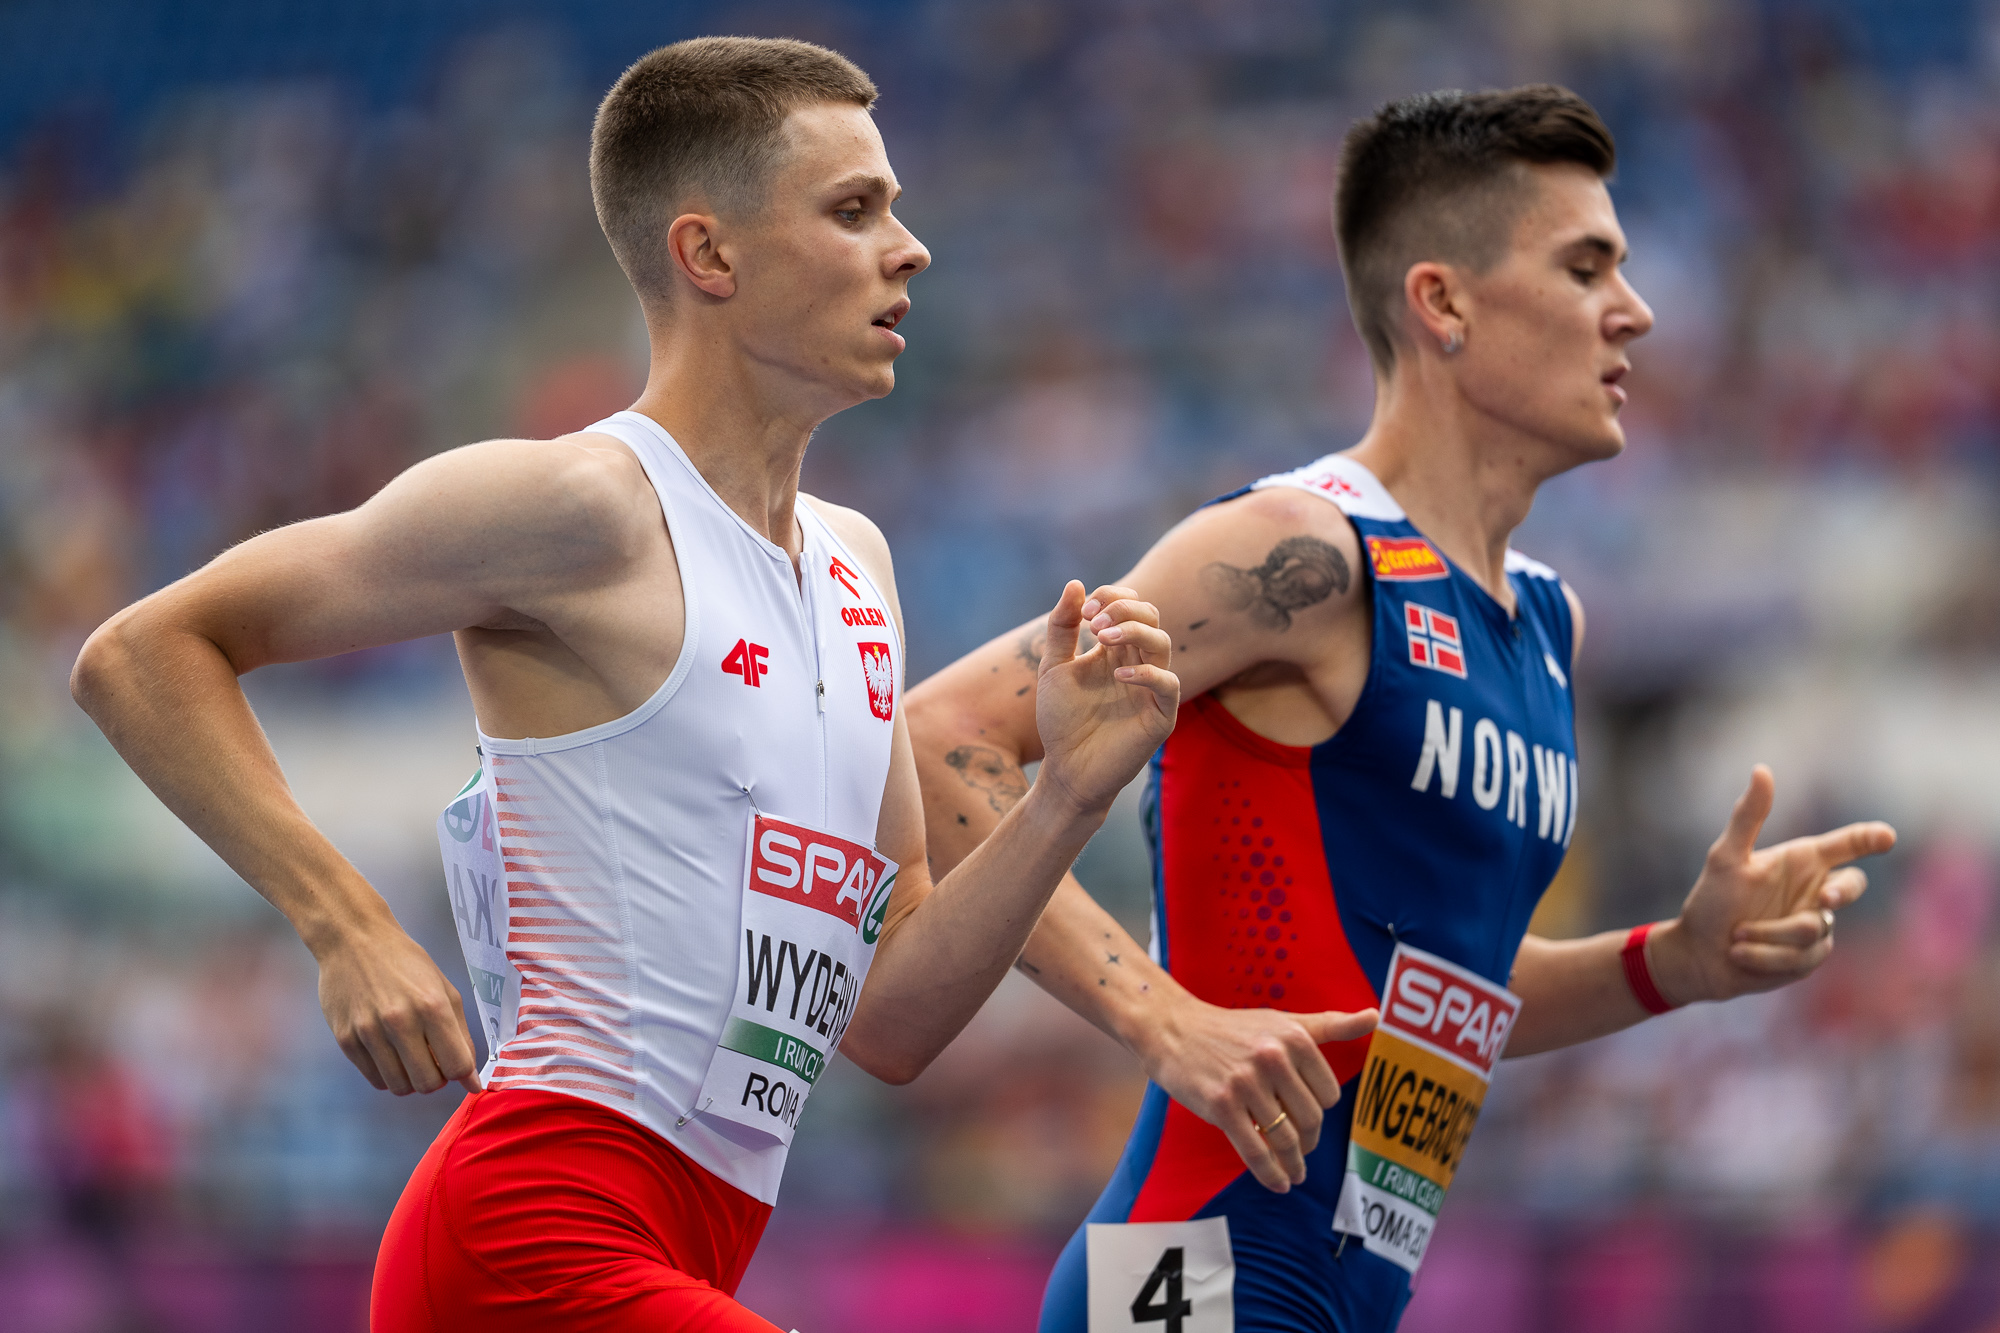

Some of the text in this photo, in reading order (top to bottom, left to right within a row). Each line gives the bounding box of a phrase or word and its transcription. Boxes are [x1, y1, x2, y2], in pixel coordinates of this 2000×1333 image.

[841, 607, 887, 627] ORLEN
[721, 638, 769, 688] 4F
[1392, 968, 1510, 1064] SPAR
[774, 1036, 783, 1060] I
[1372, 1160, 1386, 1183] I
[1129, 1246, 1192, 1333] 4
